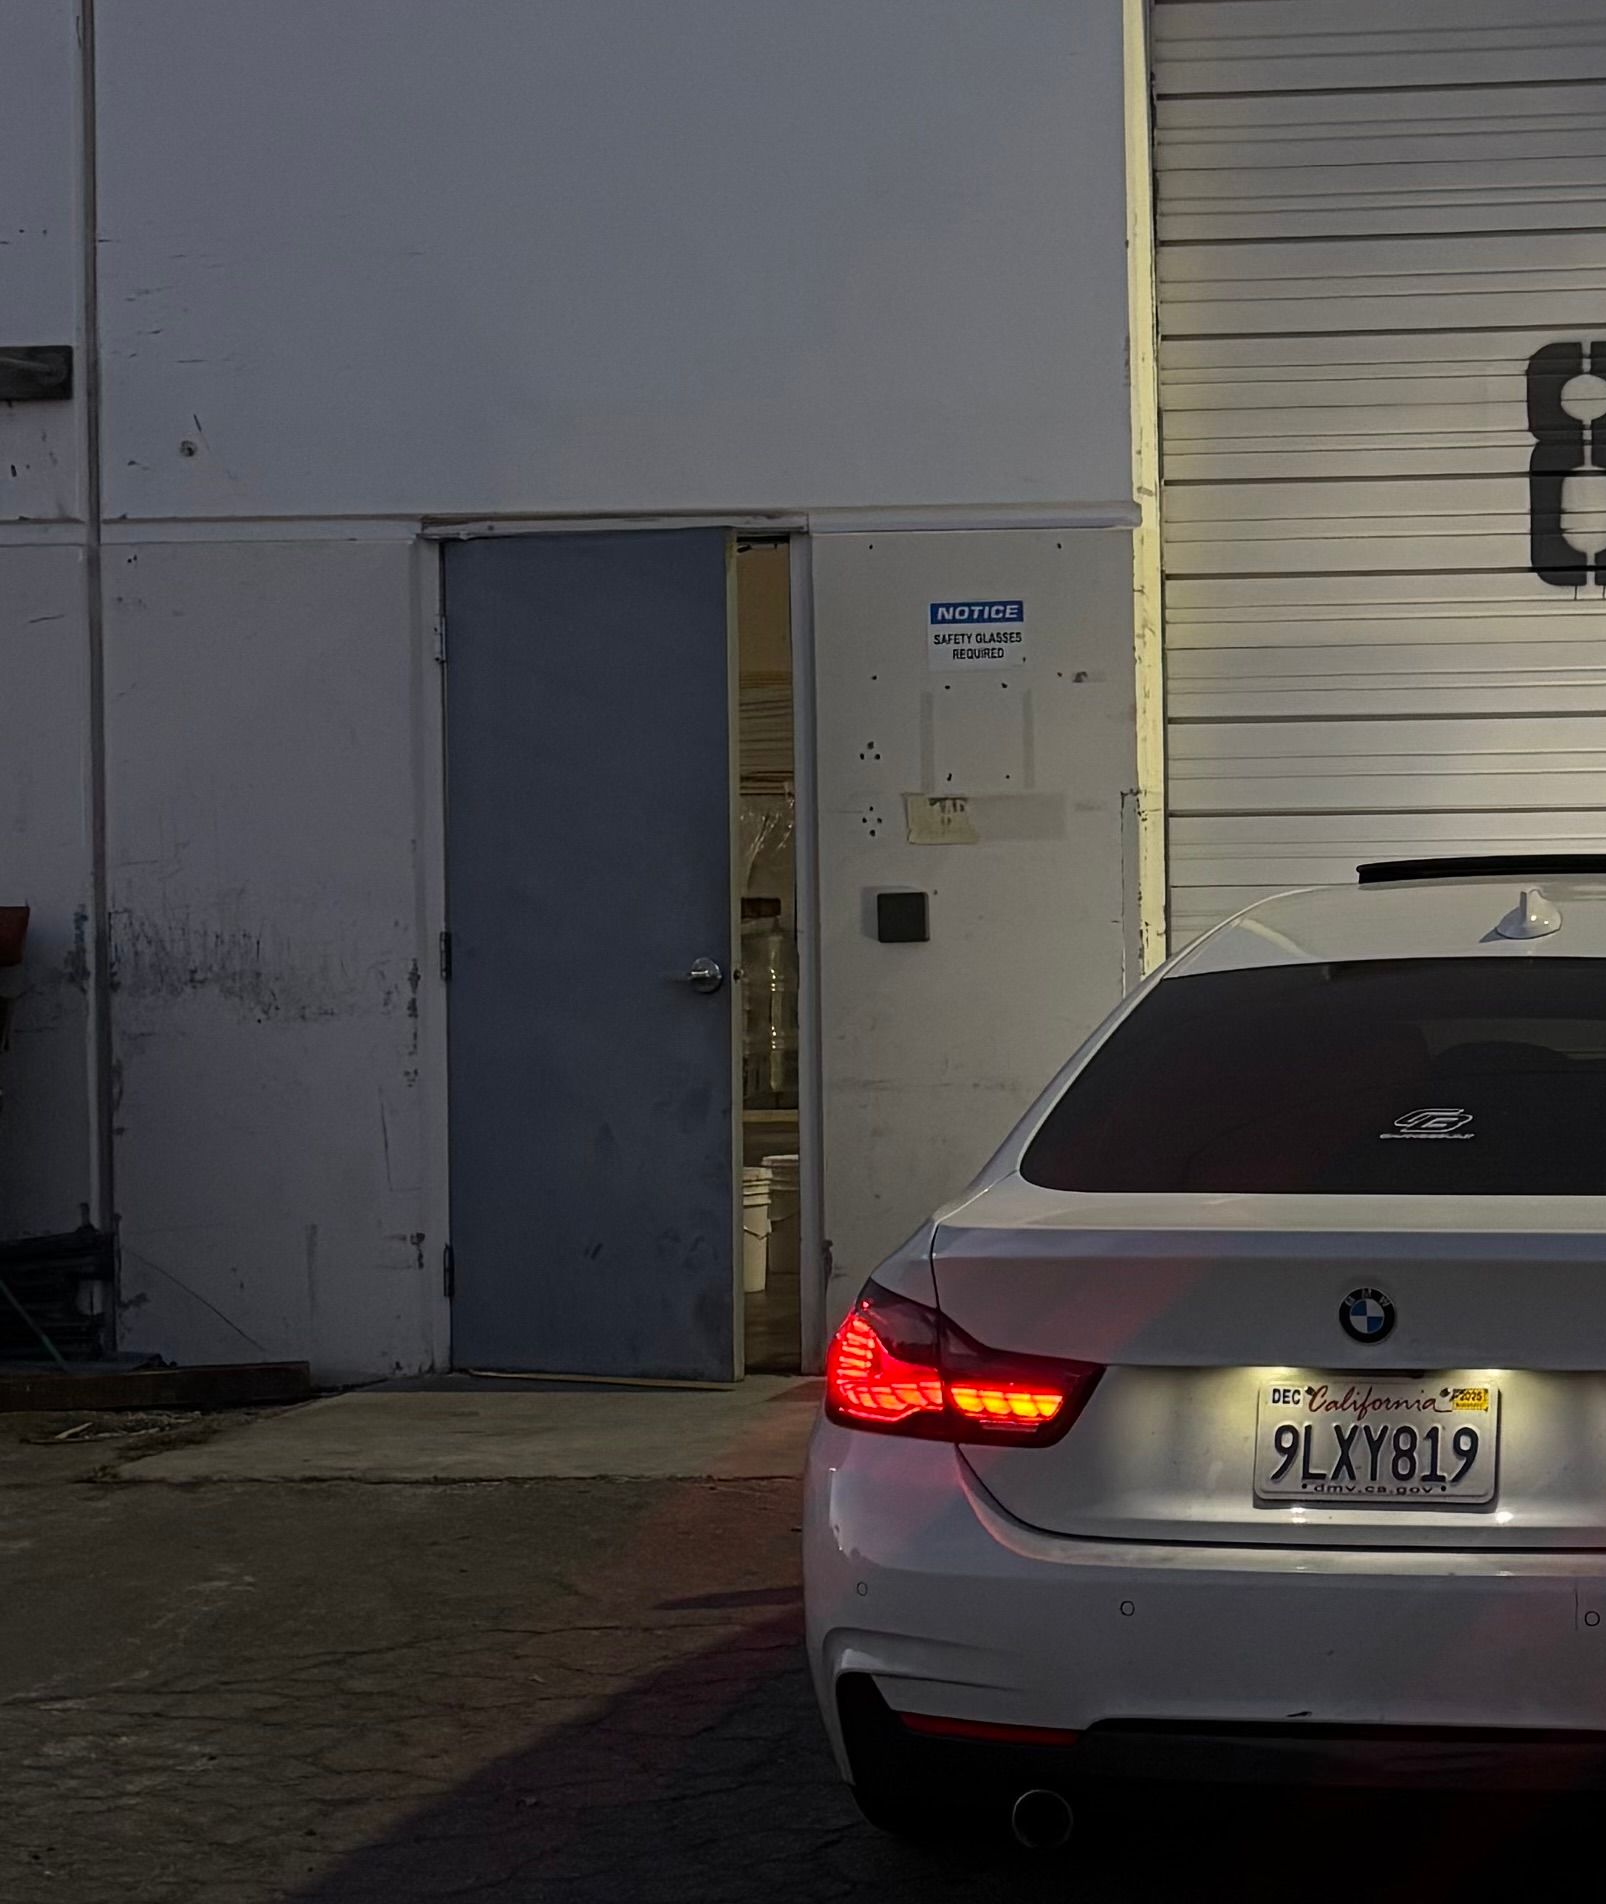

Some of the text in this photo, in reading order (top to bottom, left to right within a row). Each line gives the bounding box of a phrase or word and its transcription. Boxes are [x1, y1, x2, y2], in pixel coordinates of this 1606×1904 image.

[937, 604, 1019, 620] NOTICE
[933, 631, 1022, 645] SAFETY GLASSES
[952, 647, 1005, 660] REQUIRED
[1272, 1388, 1300, 1405] DEC
[1306, 1385, 1452, 1421] California
[1270, 1423, 1480, 1483] 9LXY819
[1313, 1483, 1434, 1495] dmv.ca.gov
